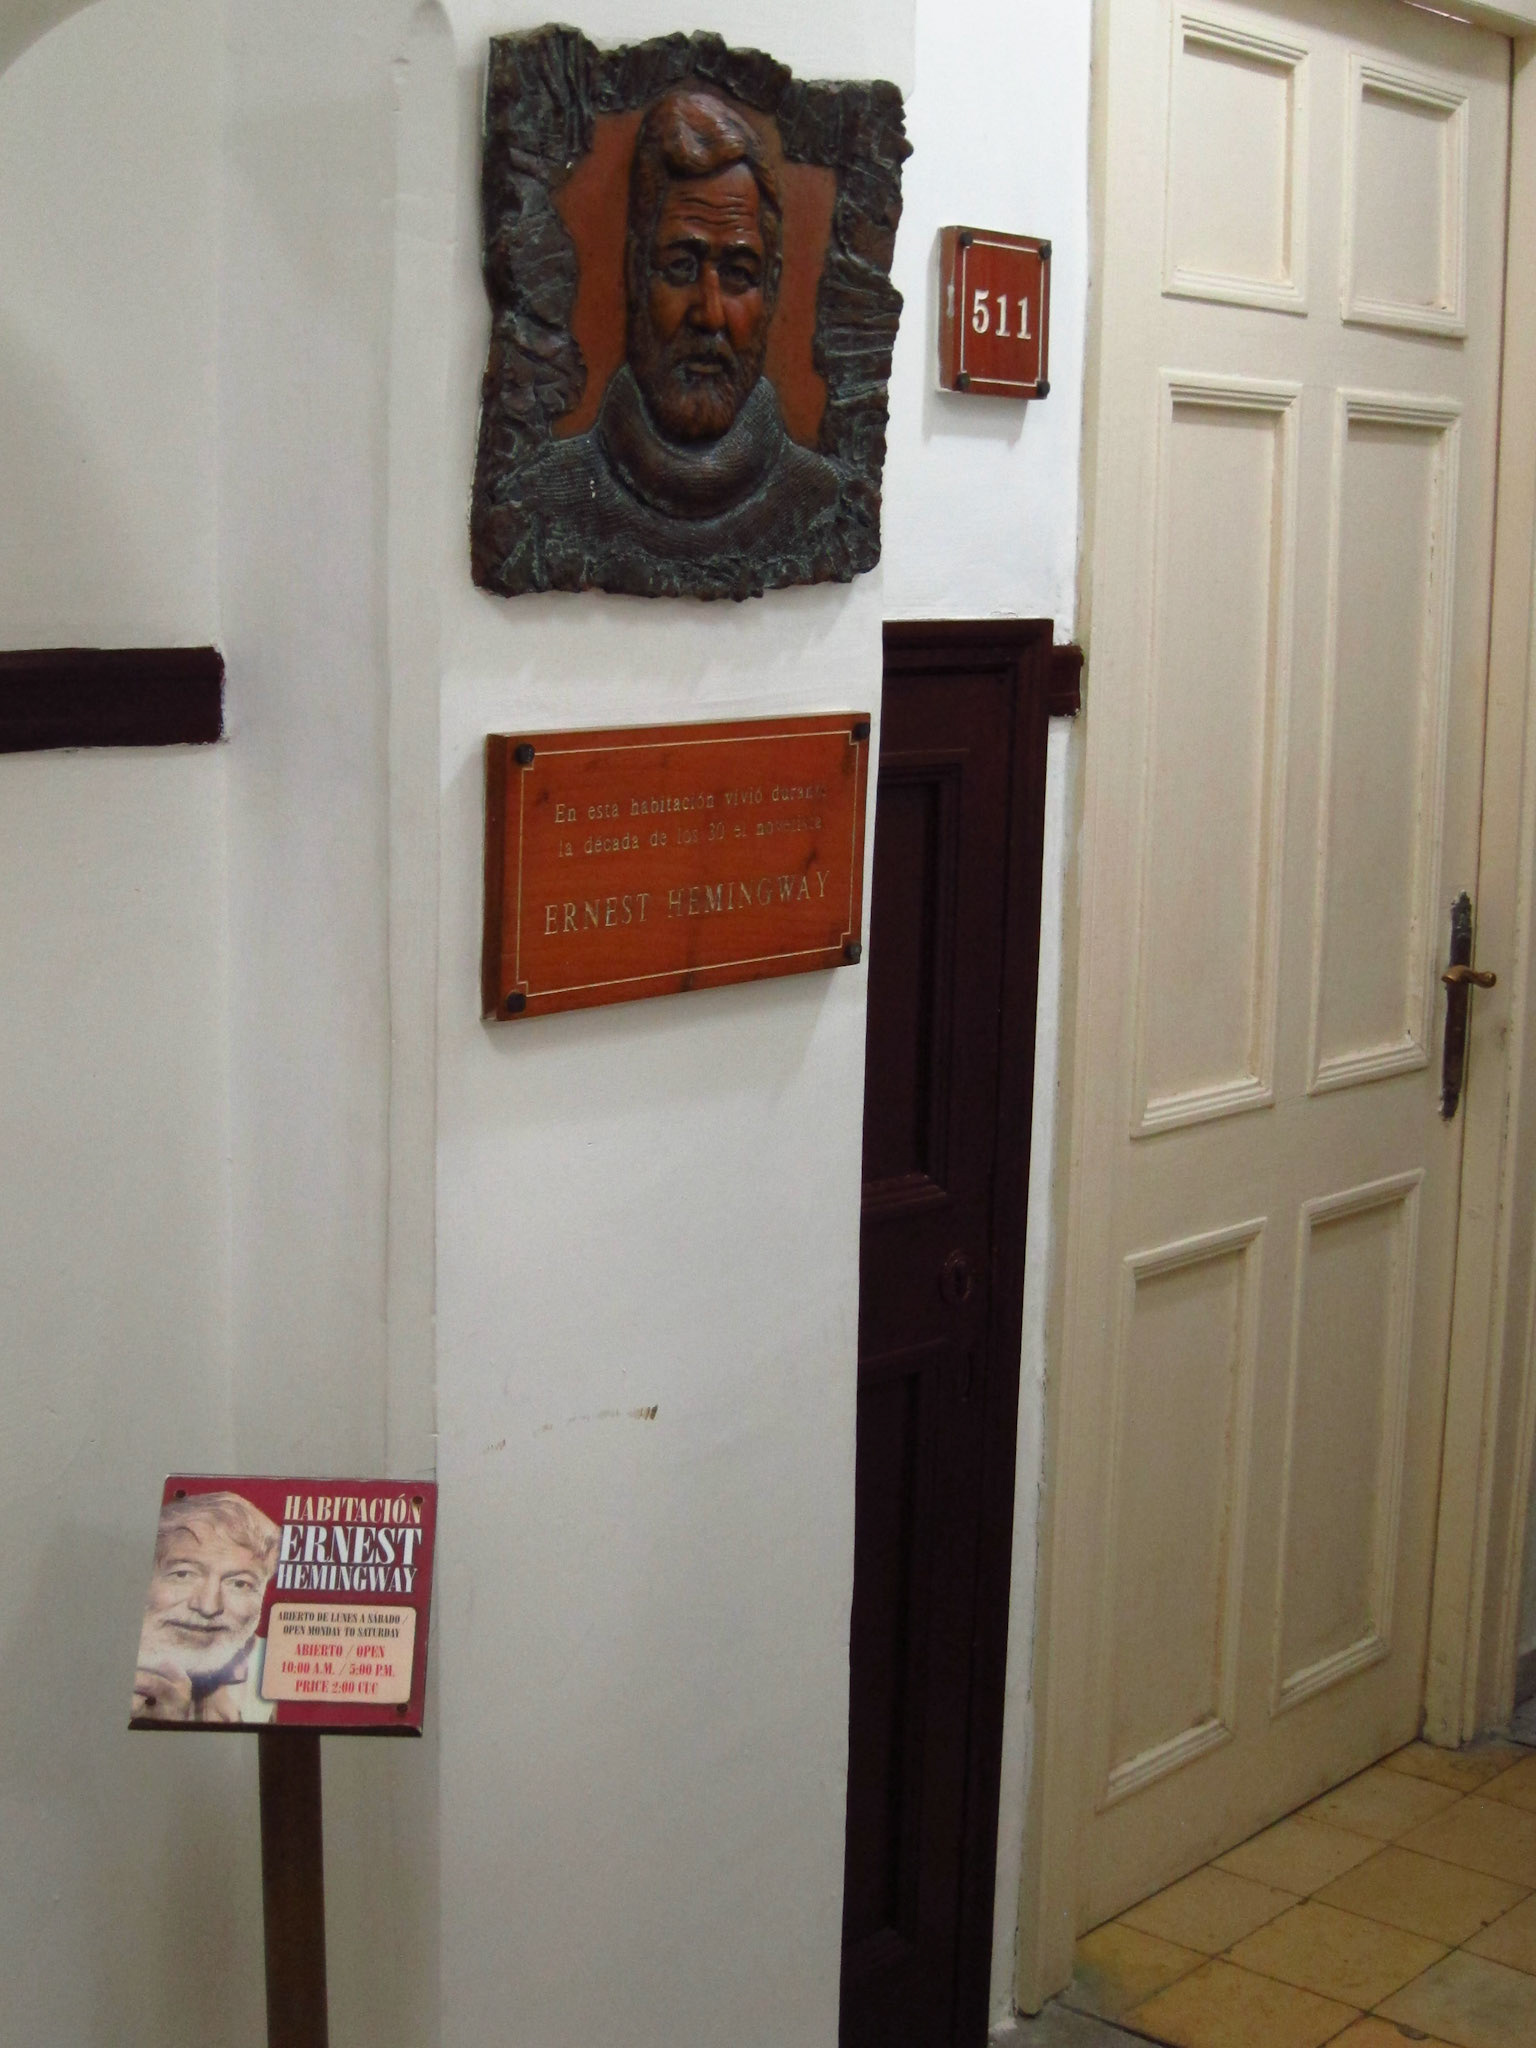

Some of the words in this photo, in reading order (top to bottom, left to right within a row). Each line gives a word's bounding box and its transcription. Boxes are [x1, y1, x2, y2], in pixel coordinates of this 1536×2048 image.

[972, 289, 1032, 340] 511
[554, 803, 577, 823] En
[587, 802, 620, 820] esta
[630, 792, 715, 816] habitación
[724, 787, 763, 807] vivió
[583, 832, 640, 854] década
[649, 830, 668, 847] de
[707, 821, 726, 841] 30
[544, 893, 650, 935] ERNEST
[667, 870, 830, 918] HEMINGWAY
[283, 1493, 422, 1524] HABITACIÓN
[280, 1524, 423, 1565] ERNEST
[276, 1563, 418, 1593] HEMINGWAY
[279, 1611, 315, 1621] ABIERTO
[317, 1612, 328, 1622] DE
[331, 1612, 357, 1623] LUNES
[359, 1614, 365, 1624] A
[283, 1625, 305, 1635] OPEN
[307, 1626, 341, 1636] MONDAY
[344, 1627, 355, 1637] TO
[357, 1627, 400, 1638] SATURDAY
[295, 1643, 343, 1657] ABIERTO
[356, 1645, 385, 1658] OPEN
[281, 1661, 310, 1674] 10:00
[349, 1663, 372, 1676] 5:00
[295, 1680, 329, 1693] PRICE
[331, 1681, 355, 1694] 2:00
